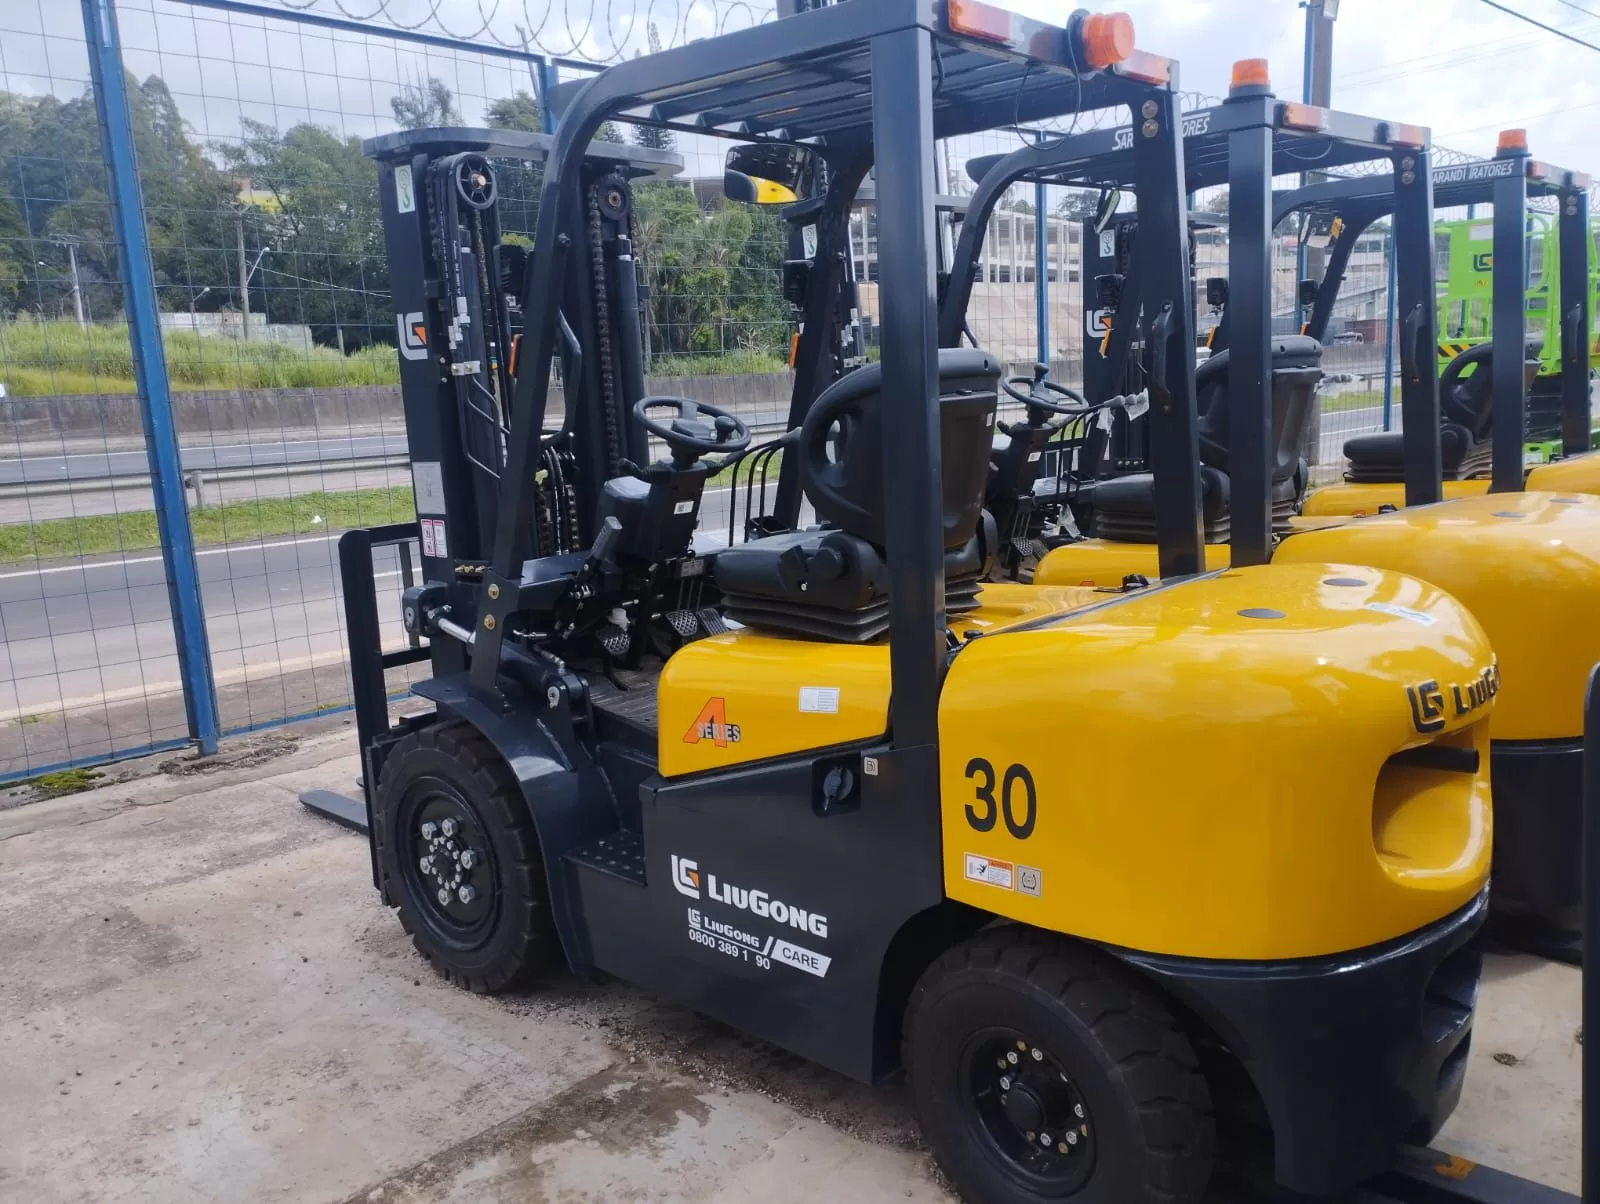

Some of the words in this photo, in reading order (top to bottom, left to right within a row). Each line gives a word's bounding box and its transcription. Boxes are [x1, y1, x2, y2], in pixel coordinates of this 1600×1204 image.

[1432, 164, 1467, 184] ARANDI
[697, 722, 742, 743] SERIES
[964, 756, 1037, 840] 30
[688, 929, 716, 949] 0800
[718, 940, 739, 958] 389
[782, 946, 820, 970] CARE
